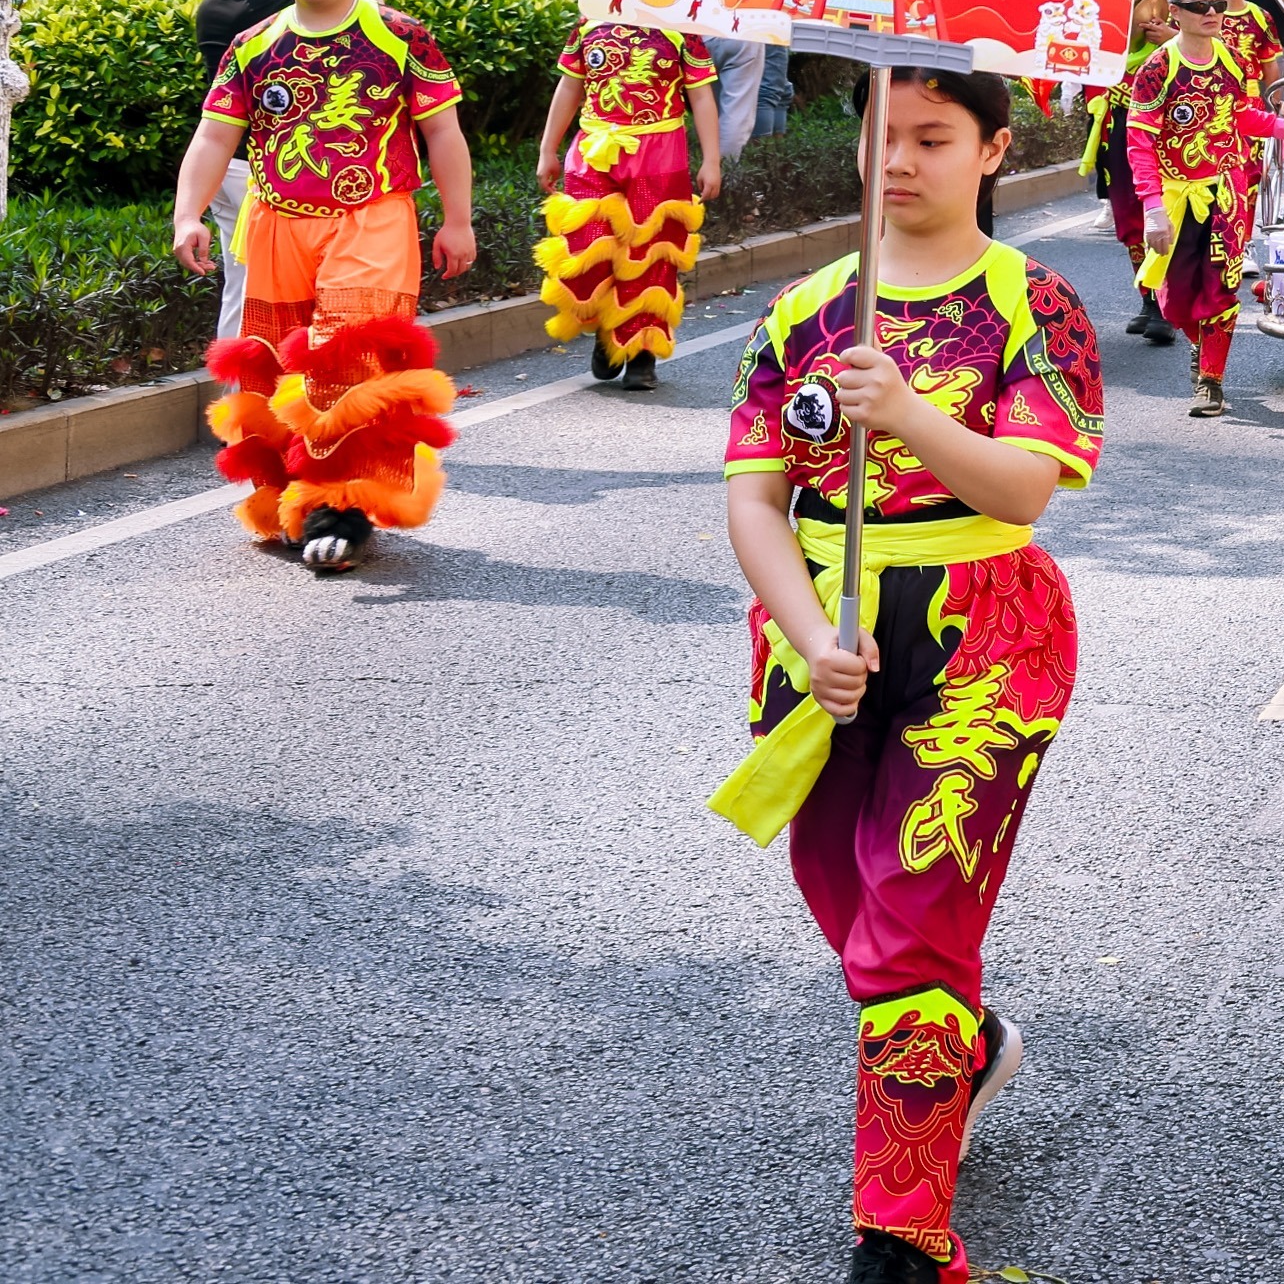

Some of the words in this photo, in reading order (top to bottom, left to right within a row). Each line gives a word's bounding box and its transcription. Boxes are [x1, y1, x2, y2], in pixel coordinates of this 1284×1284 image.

[277, 71, 373, 182] 姜氏
[1182, 94, 1235, 171] 姜氏
[1053, 383, 1081, 424] DRAGON
[899, 662, 1019, 884] 姜氏
